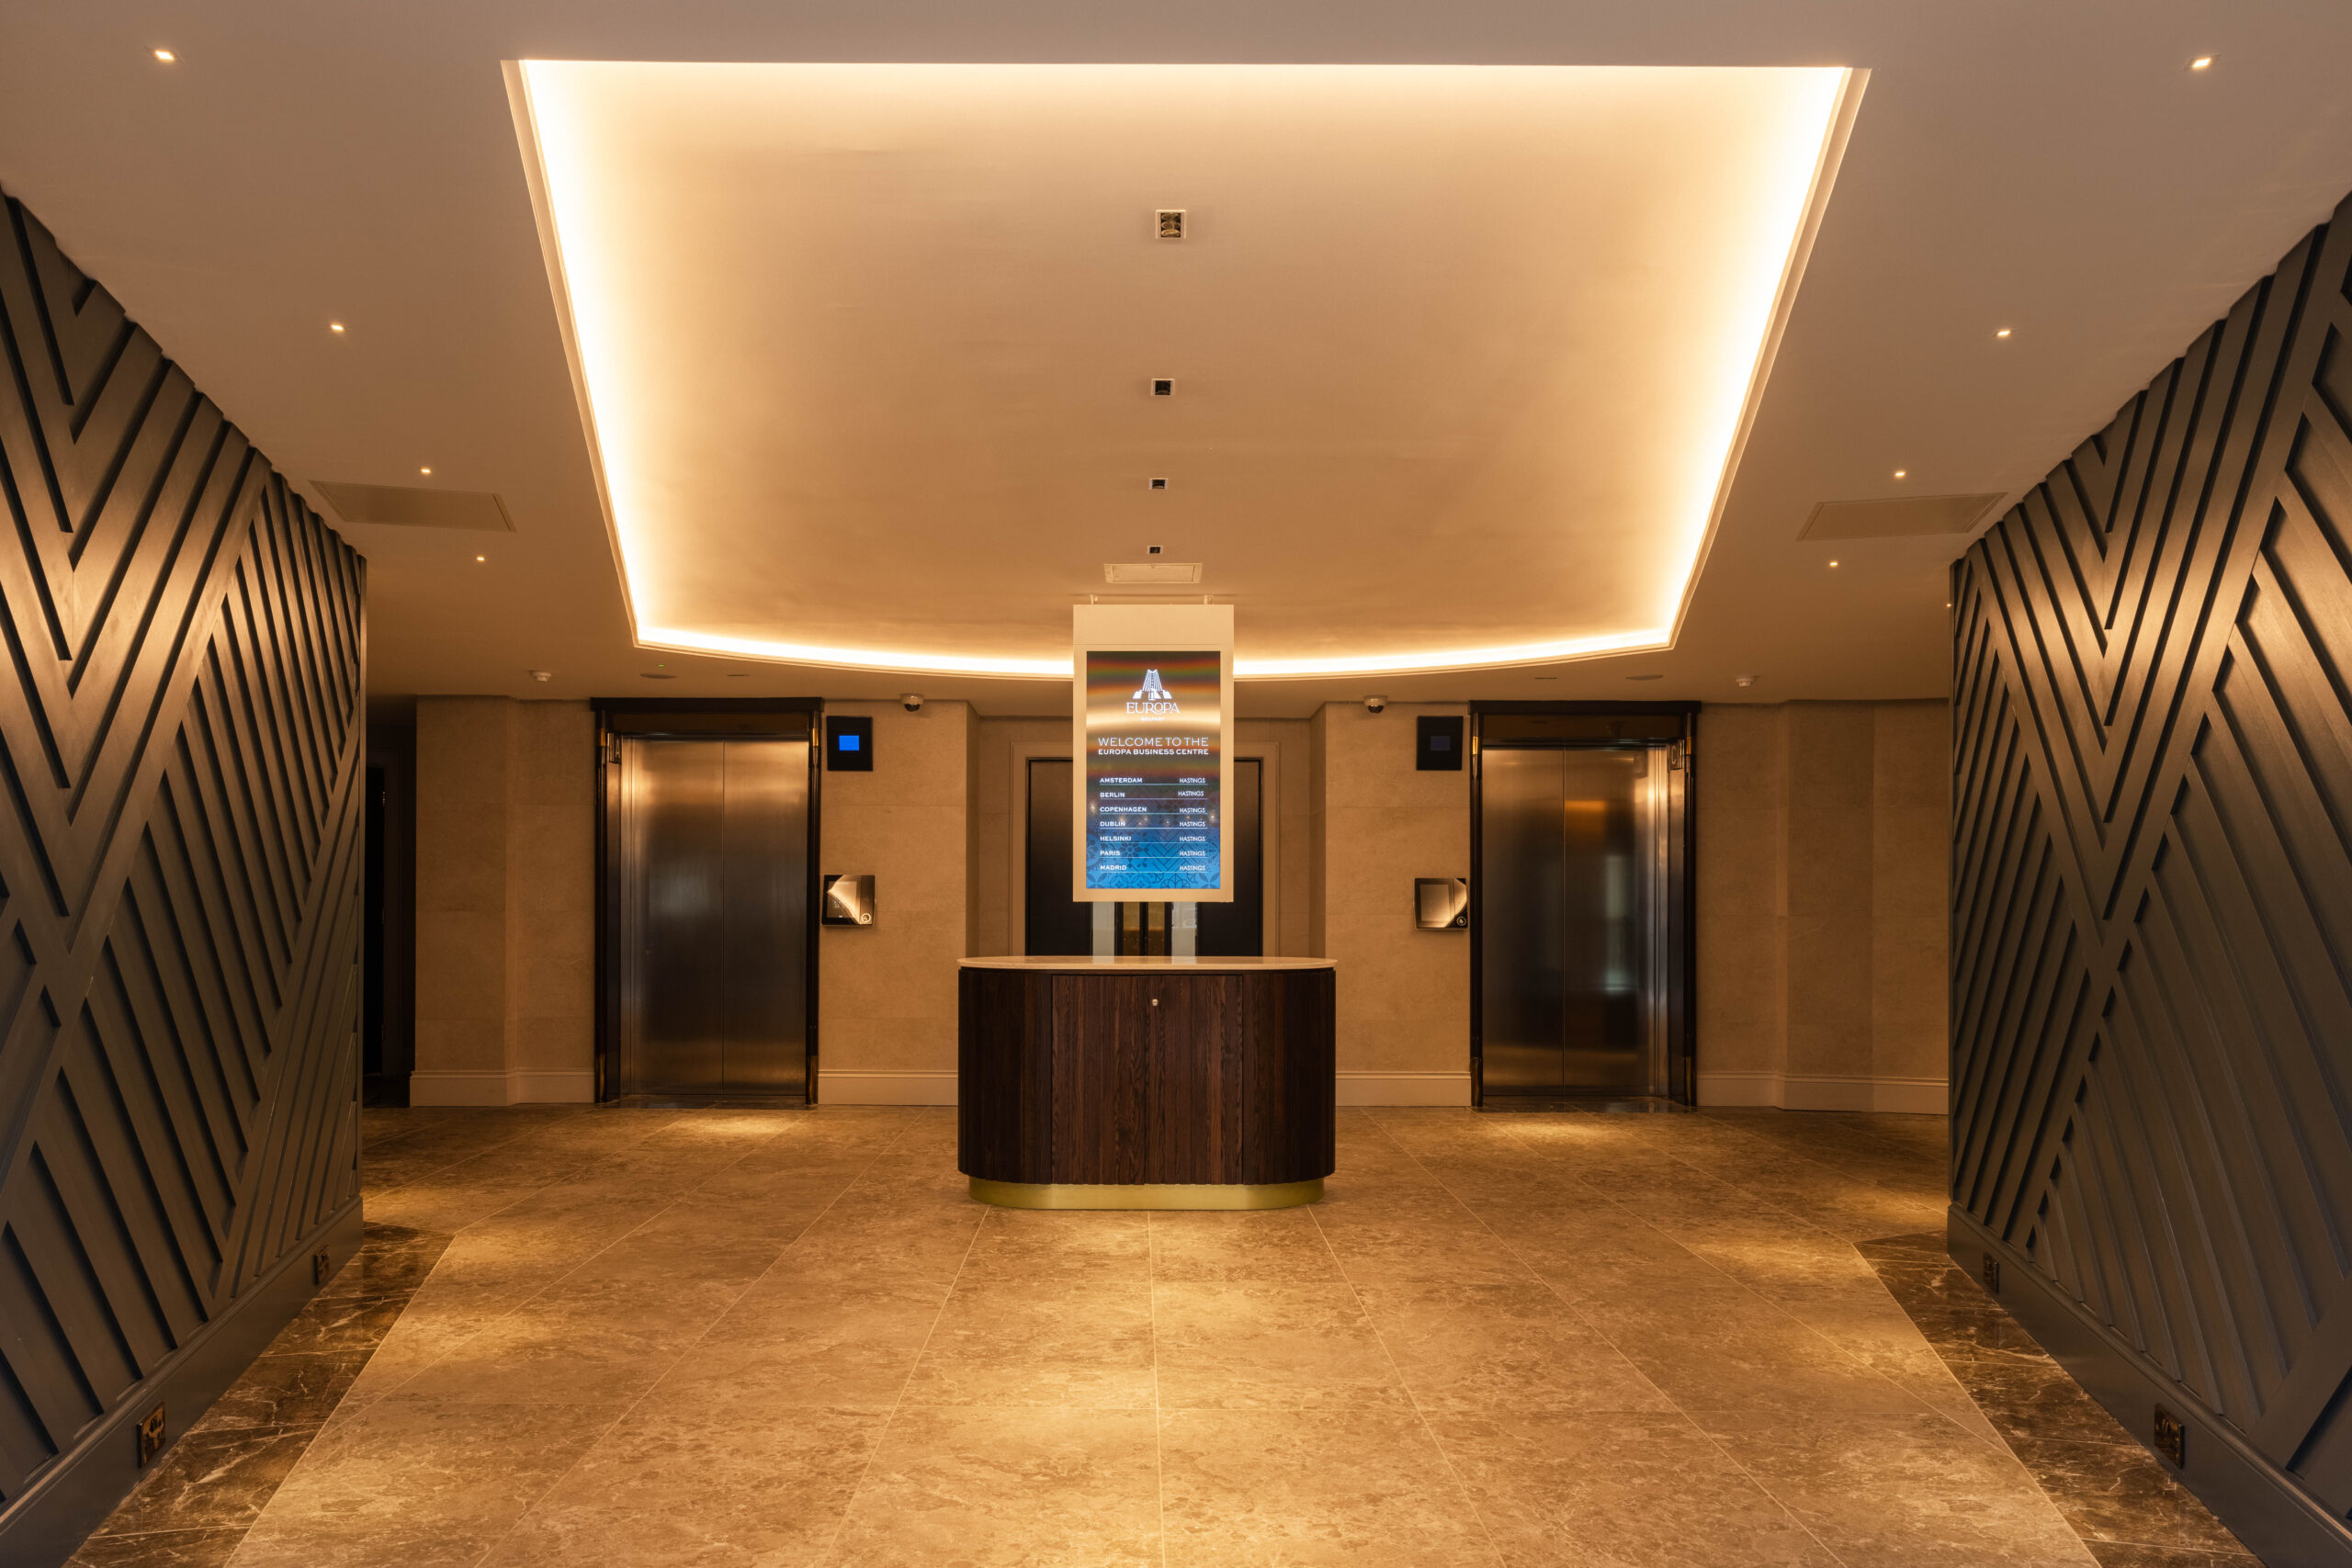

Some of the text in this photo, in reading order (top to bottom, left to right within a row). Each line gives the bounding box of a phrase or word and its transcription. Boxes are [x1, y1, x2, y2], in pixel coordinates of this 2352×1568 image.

[1126, 702, 1180, 714] EUROPA
[1098, 738, 1209, 747] WELCOME TO THE
